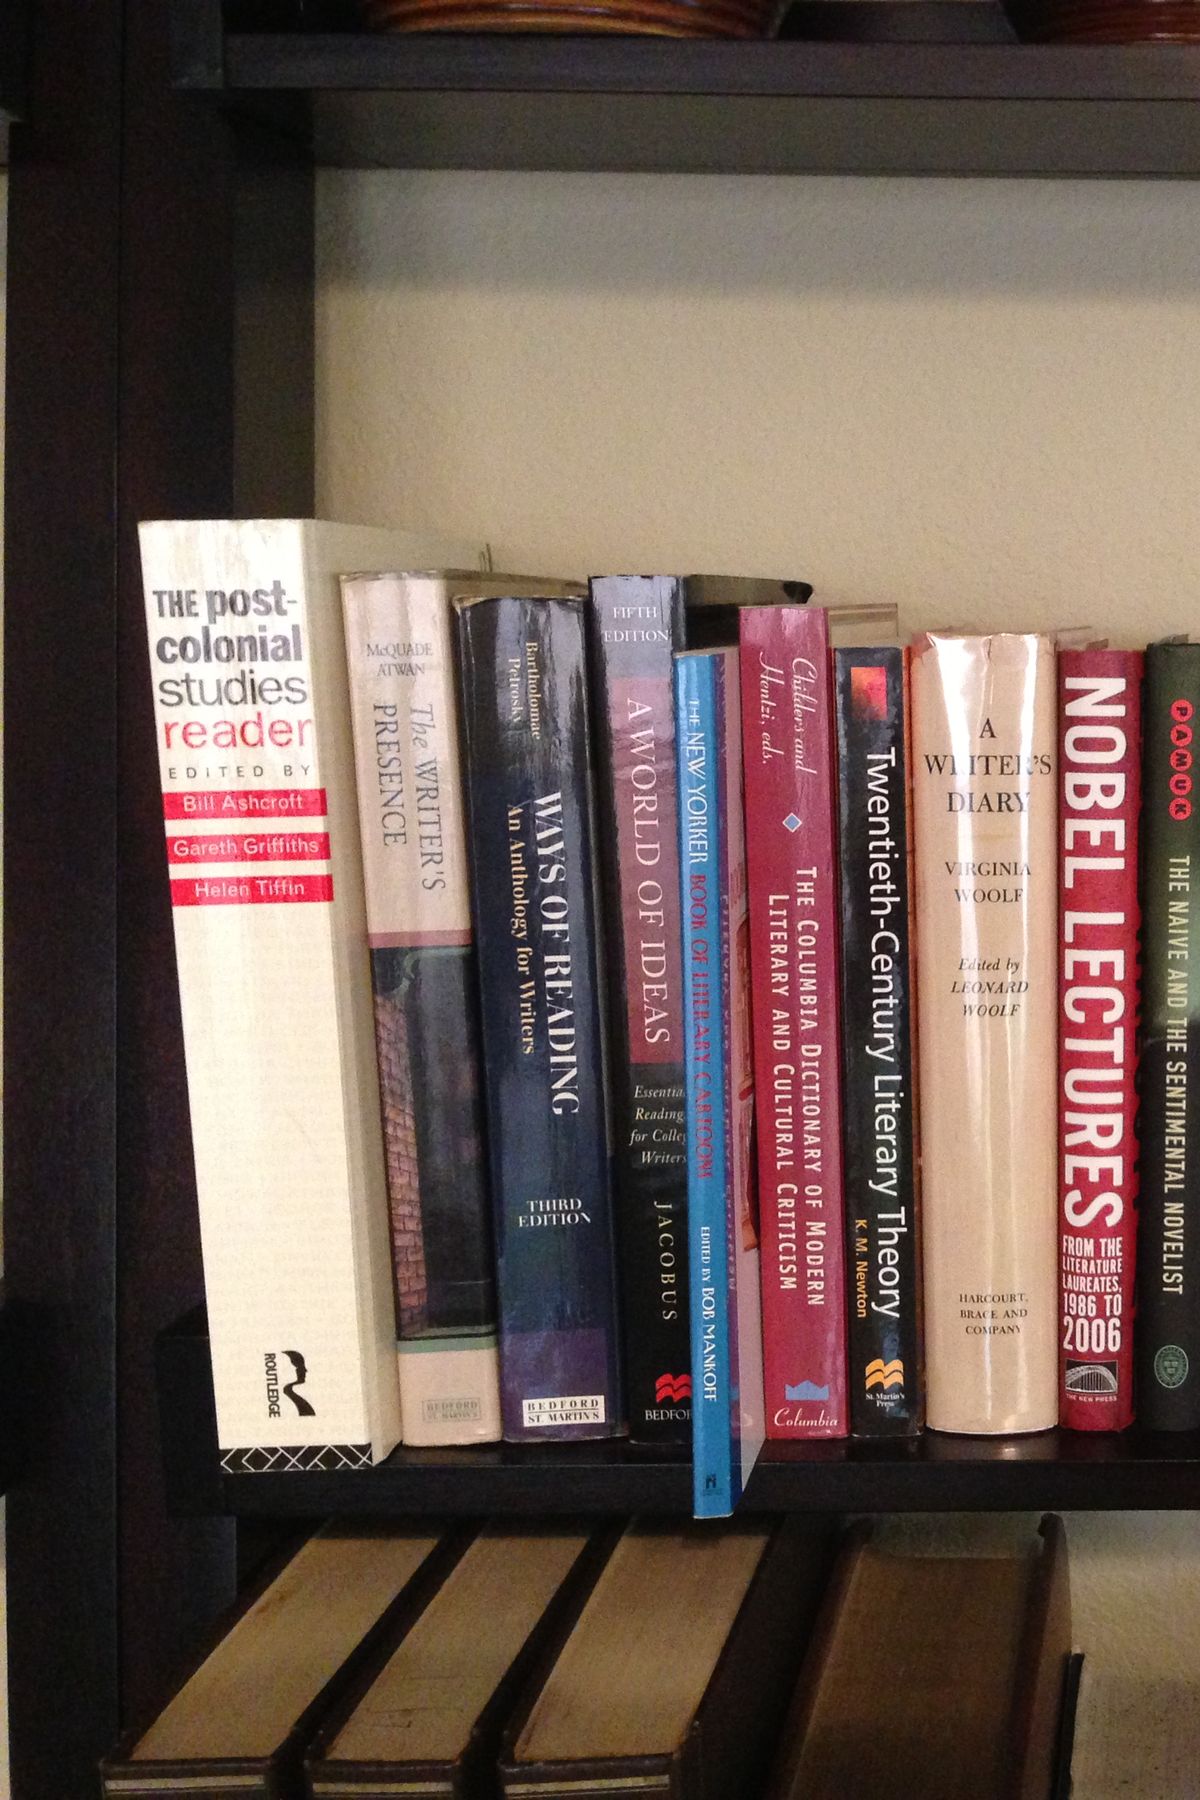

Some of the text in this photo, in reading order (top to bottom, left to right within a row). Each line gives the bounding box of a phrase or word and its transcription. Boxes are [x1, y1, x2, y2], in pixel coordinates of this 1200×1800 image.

[153, 590, 199, 617] THE
[613, 606, 658, 619] FIFTH
[156, 624, 303, 664] colonial
[158, 670, 308, 707] studies
[164, 711, 312, 749] reader
[979, 718, 997, 738] A
[168, 765, 311, 780] EDITED BY
[373, 703, 407, 847] PRESENCE
[183, 794, 303, 812] Bill Ashcroft
[947, 792, 1031, 812] DIARY
[686, 732, 708, 930] NEW YORKER BOOK
[173, 838, 319, 857] Gareth Griffiths
[627, 698, 670, 1044] A WORLD OF IDEAS
[945, 862, 1032, 877] VIRGINIA
[195, 880, 304, 898] Helen Tiffin
[954, 889, 1024, 903] WOOLF
[507, 805, 536, 1054] An Anthology for Writers
[534, 792, 580, 1115] WAYS OF READING
[1063, 677, 1127, 1228] NOBEL LECTURES
[962, 1004, 1021, 1017] WOOLF
[797, 866, 827, 1305] THE COLUMBIA DICTIONARY OF MODERN
[1162, 856, 1190, 1294] THE NAIVE AND THE SENTIMENTAL NOVELIST
[769, 895, 798, 1289] LITERARY AND CULTURAL CRITICISM
[526, 1198, 582, 1212] THIRD
[869, 1075, 907, 1318] Literary Theory
[1063, 1235, 1123, 1257] FROM THE
[654, 1201, 678, 1320] JACOBUS
[1063, 1256, 1123, 1273] LITERATURE
[856, 1261, 868, 1318] Newton
[1063, 1273, 1122, 1293] LAUREATES,
[701, 1227, 717, 1403] EDITED BY BOB MANKOFF
[960, 1308, 1028, 1319] BRACE AND
[1063, 1292, 1122, 1317] 1986 TO
[965, 1324, 1021, 1335] COMPANY
[1063, 1316, 1121, 1353] 2006
[264, 1353, 281, 1418] ROUTLEDGE
[527, 1399, 599, 1411] BEDFORD
[774, 1407, 839, 1427] Columbia
